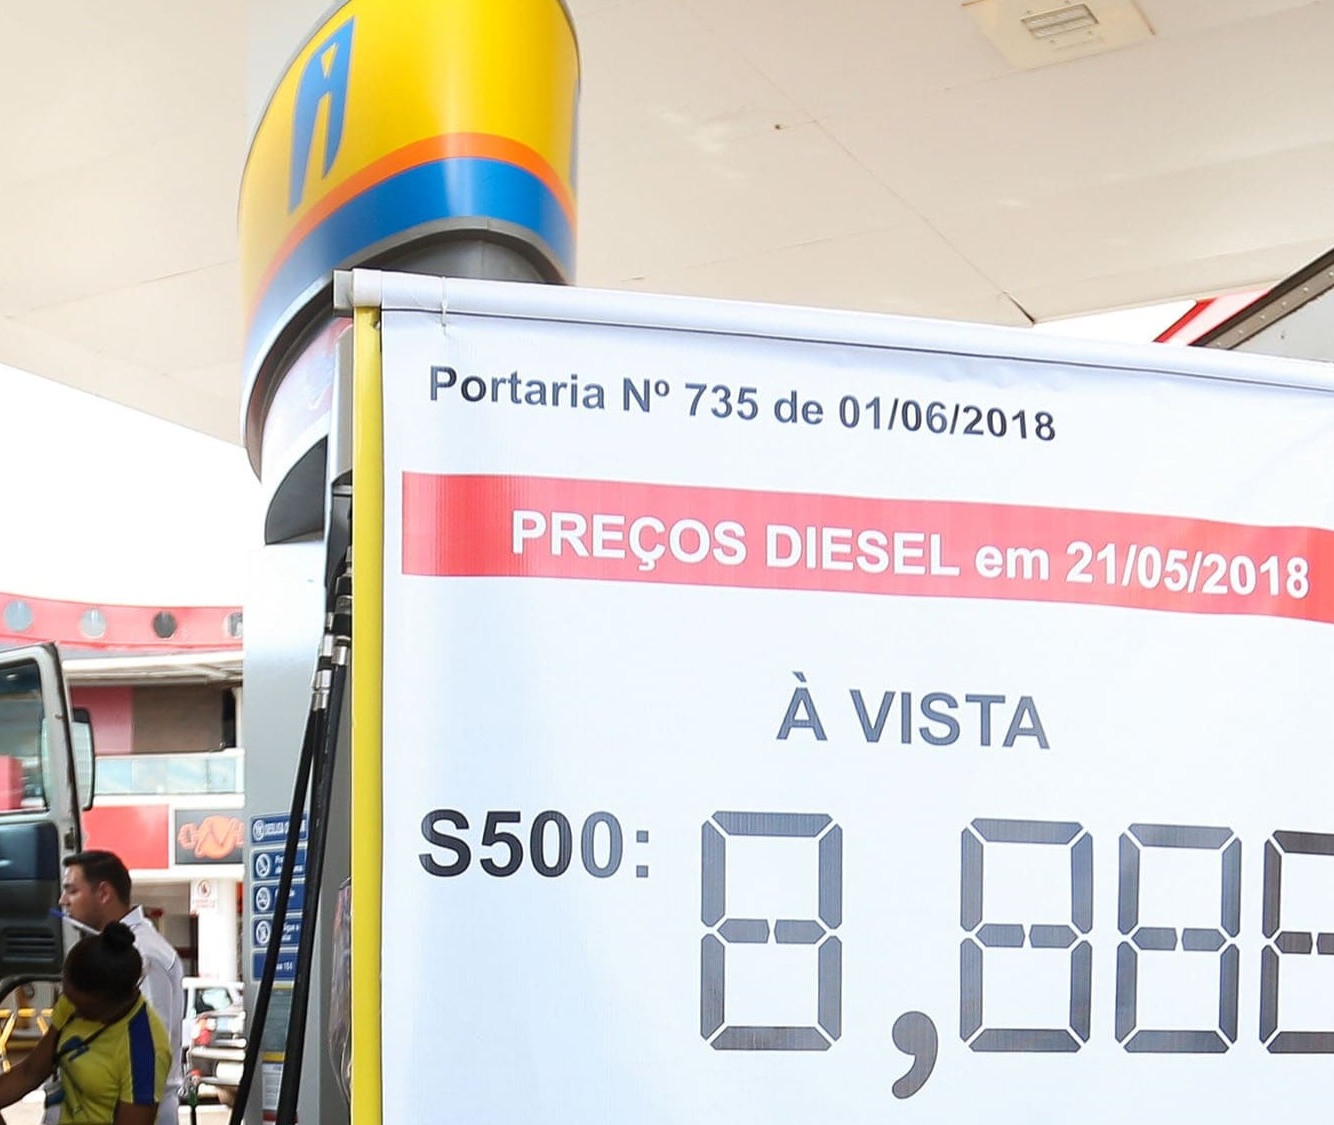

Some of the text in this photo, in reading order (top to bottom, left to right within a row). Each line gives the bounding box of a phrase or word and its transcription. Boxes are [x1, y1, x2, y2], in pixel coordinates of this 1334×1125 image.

[430, 366, 1056, 442] Portaria Nº 735 de 01/06/2018
[513, 510, 1309, 599] PREÇOS DIESEL em 21/05/2018
[775, 671, 1050, 750] À VISTA
[418, 808, 650, 879] S500:
